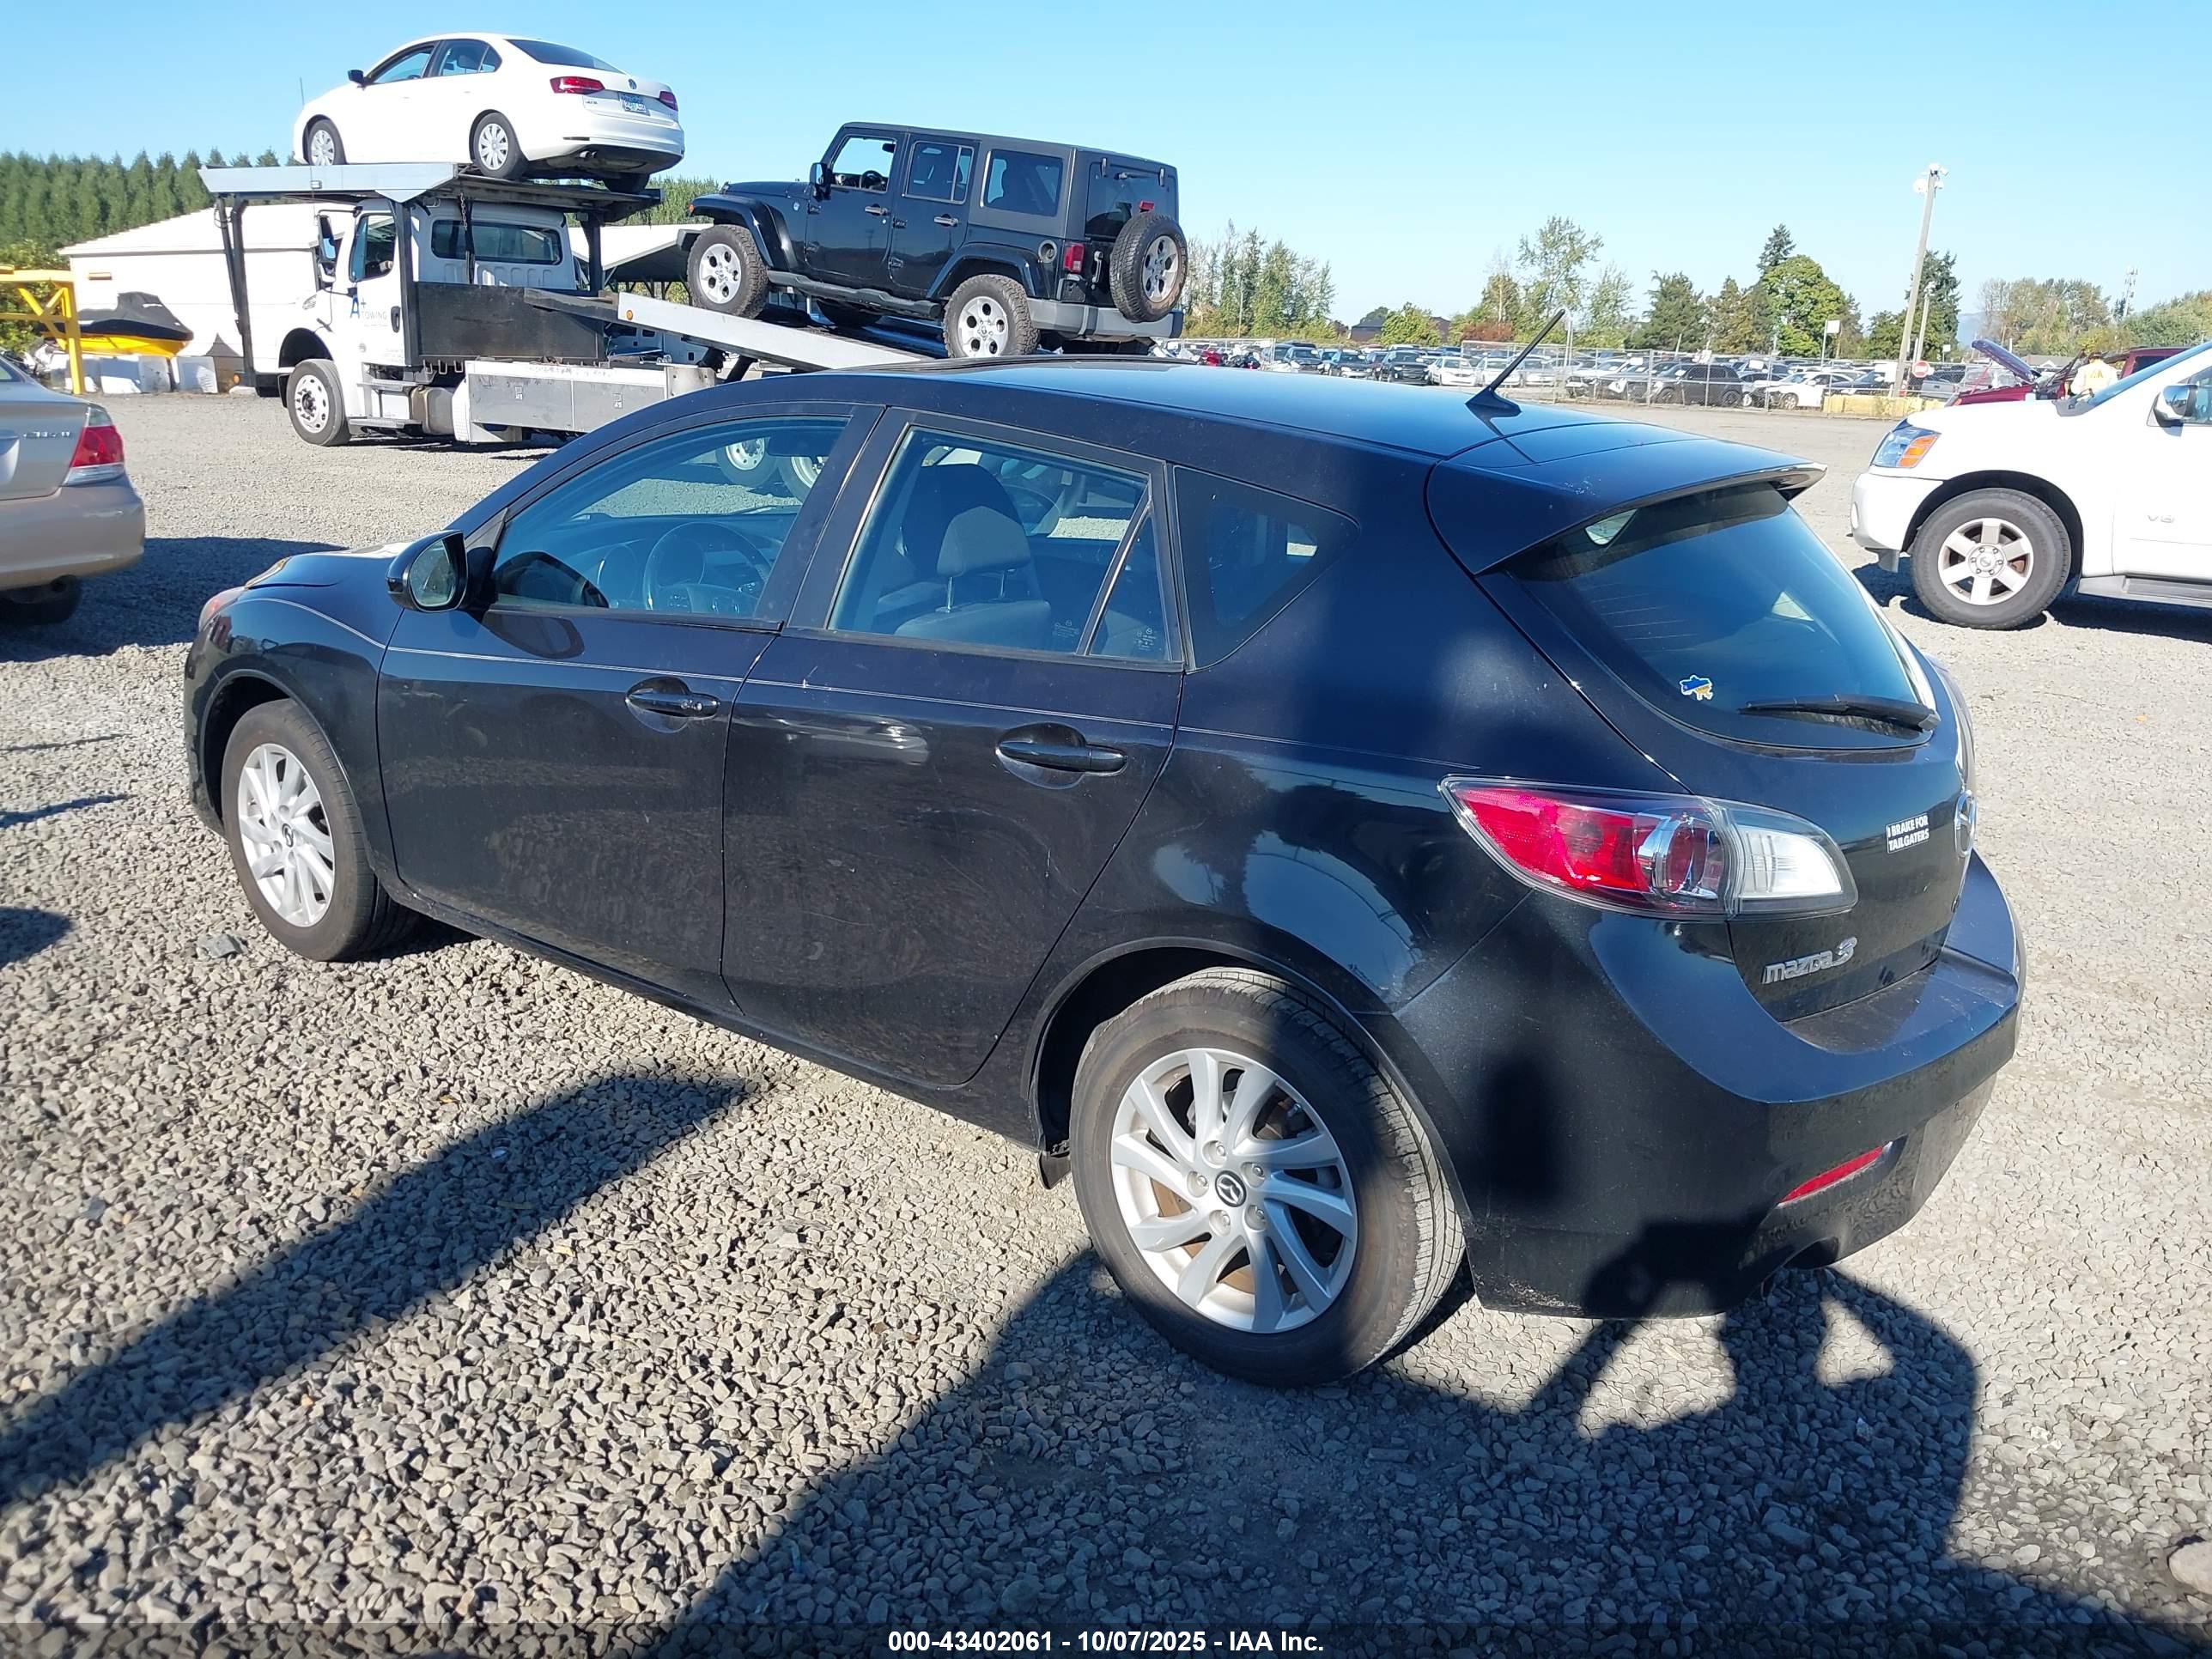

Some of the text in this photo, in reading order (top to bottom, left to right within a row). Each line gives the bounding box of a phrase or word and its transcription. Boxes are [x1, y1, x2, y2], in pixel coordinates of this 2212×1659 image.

[362, 310, 387, 320] TOWING
[1887, 815, 1929, 838] I BRAKE FOR
[1888, 828, 1930, 851] TAILGATERS
